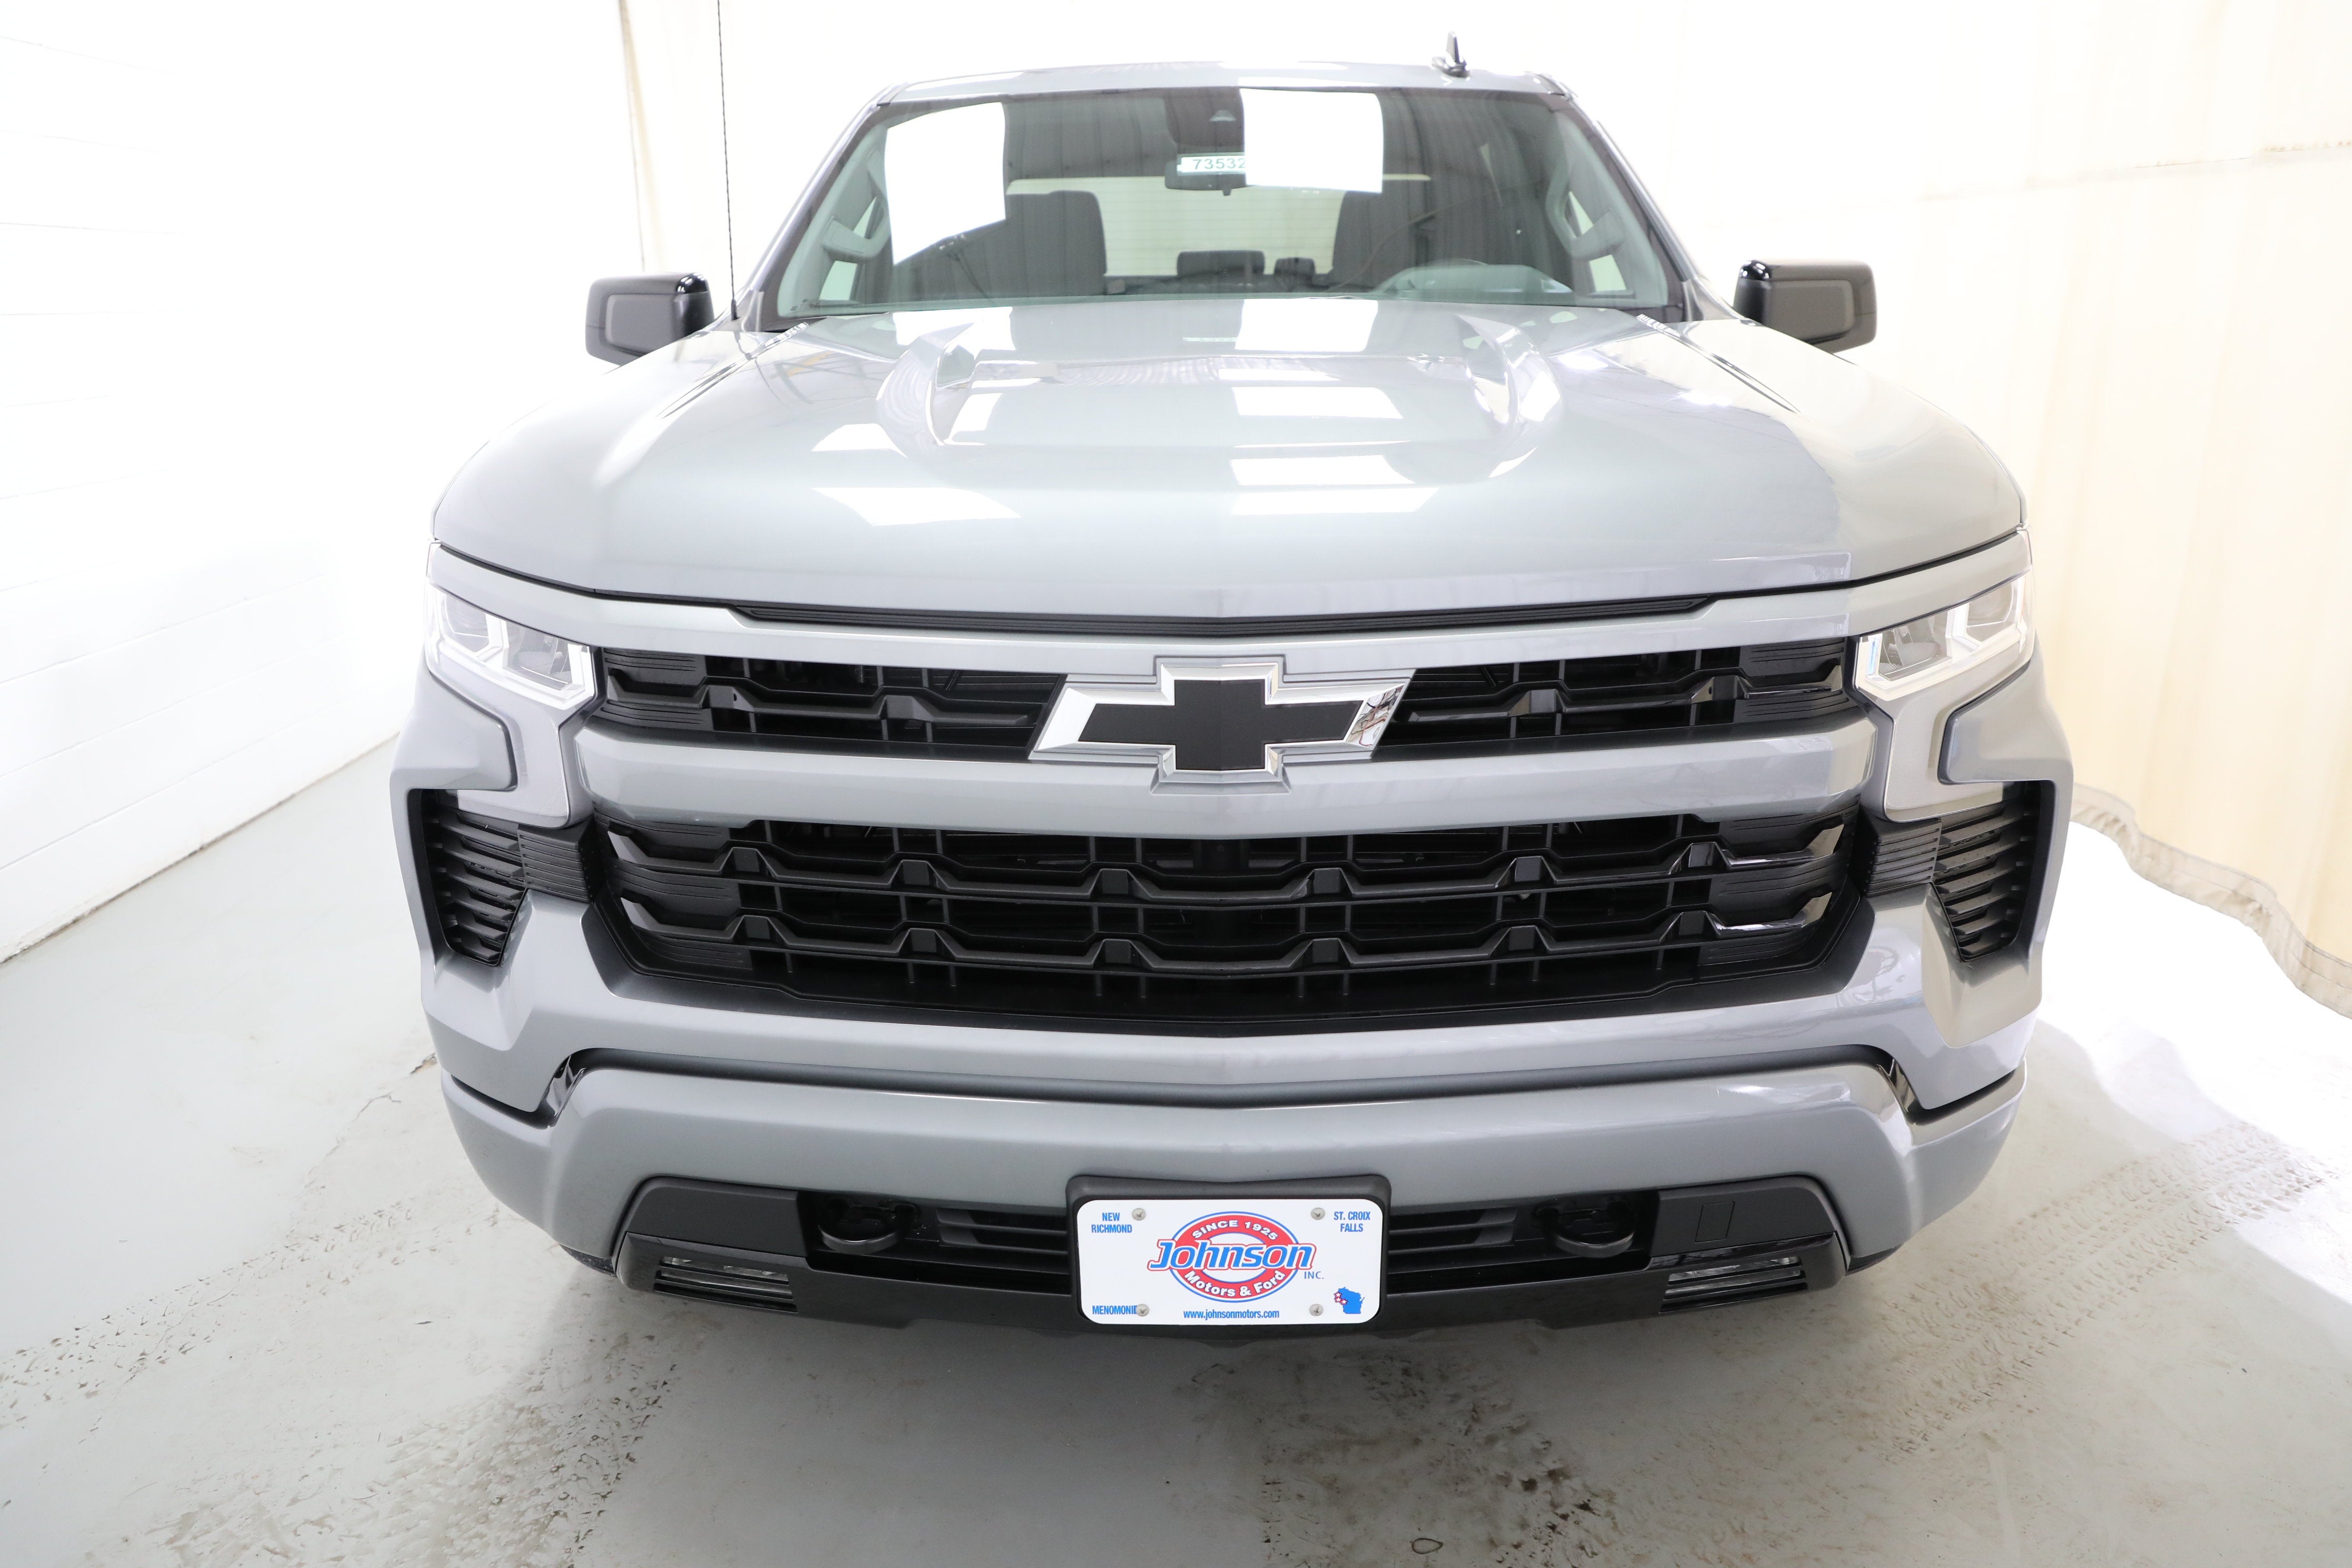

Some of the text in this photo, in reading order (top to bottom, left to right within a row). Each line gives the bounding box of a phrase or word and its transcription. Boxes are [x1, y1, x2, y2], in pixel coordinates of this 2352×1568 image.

[1192, 158, 1246, 170] 73532
[1102, 1212, 1120, 1221] NEW
[1334, 1211, 1371, 1220] ST. CROIX
[1091, 1224, 1132, 1233] RICHMOND
[1192, 1220, 1278, 1240] SINCE 1925
[1340, 1223, 1364, 1232] FALLS
[1149, 1240, 1315, 1269] Johnson
[1184, 1270, 1286, 1297] Motors & Ford
[1183, 1309, 1280, 1320] www.johnsonmotors.com
